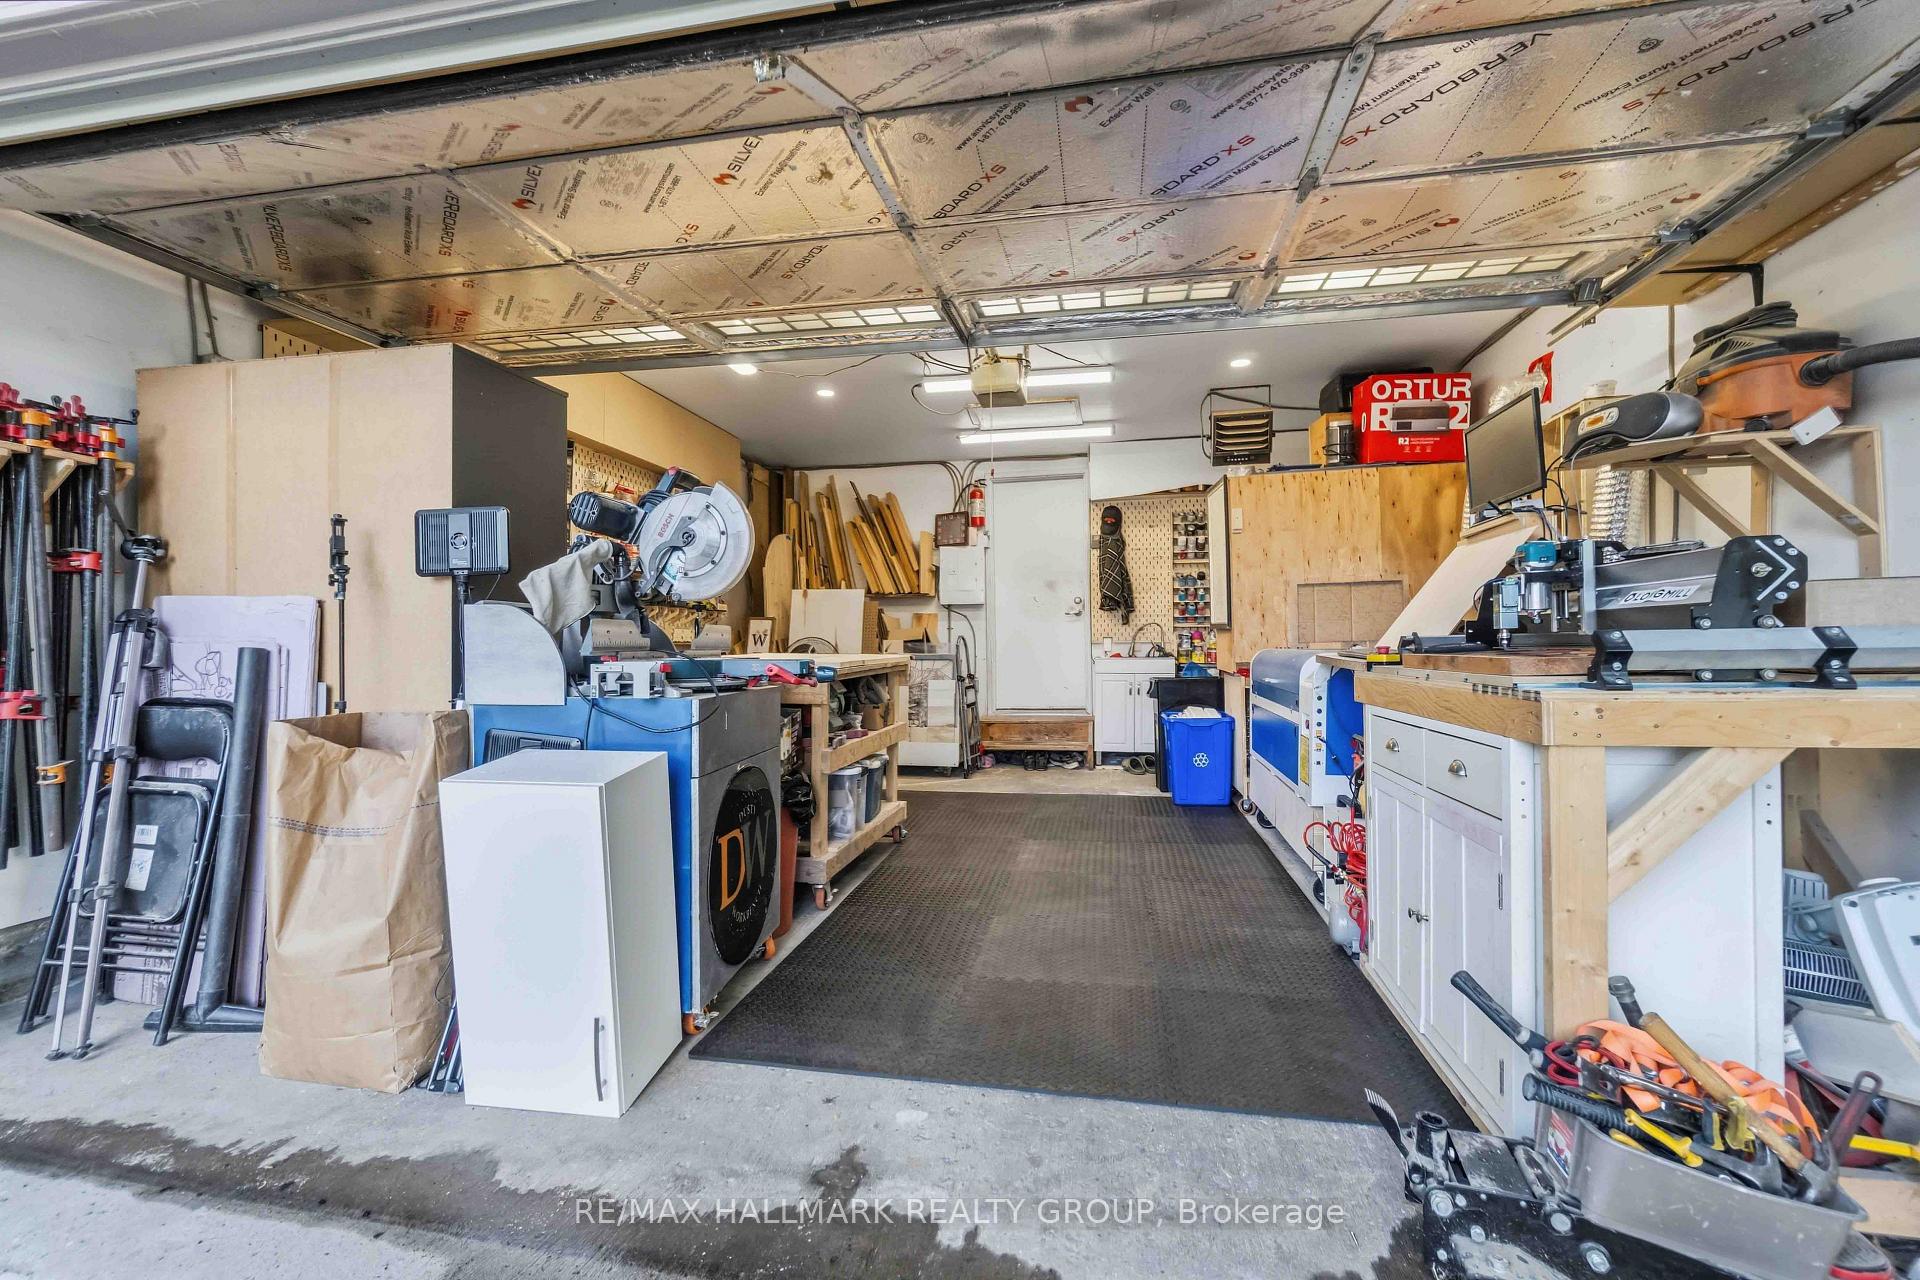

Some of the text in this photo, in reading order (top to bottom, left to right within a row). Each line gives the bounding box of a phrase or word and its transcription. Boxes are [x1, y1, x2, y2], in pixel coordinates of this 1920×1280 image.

[1221, 134, 1256, 156] XS
[1340, 126, 1377, 147] XS
[980, 164, 1007, 183] XS
[1371, 377, 1472, 400] ORTUR
[657, 513, 674, 538] BOSCH
[752, 633, 768, 647] W
